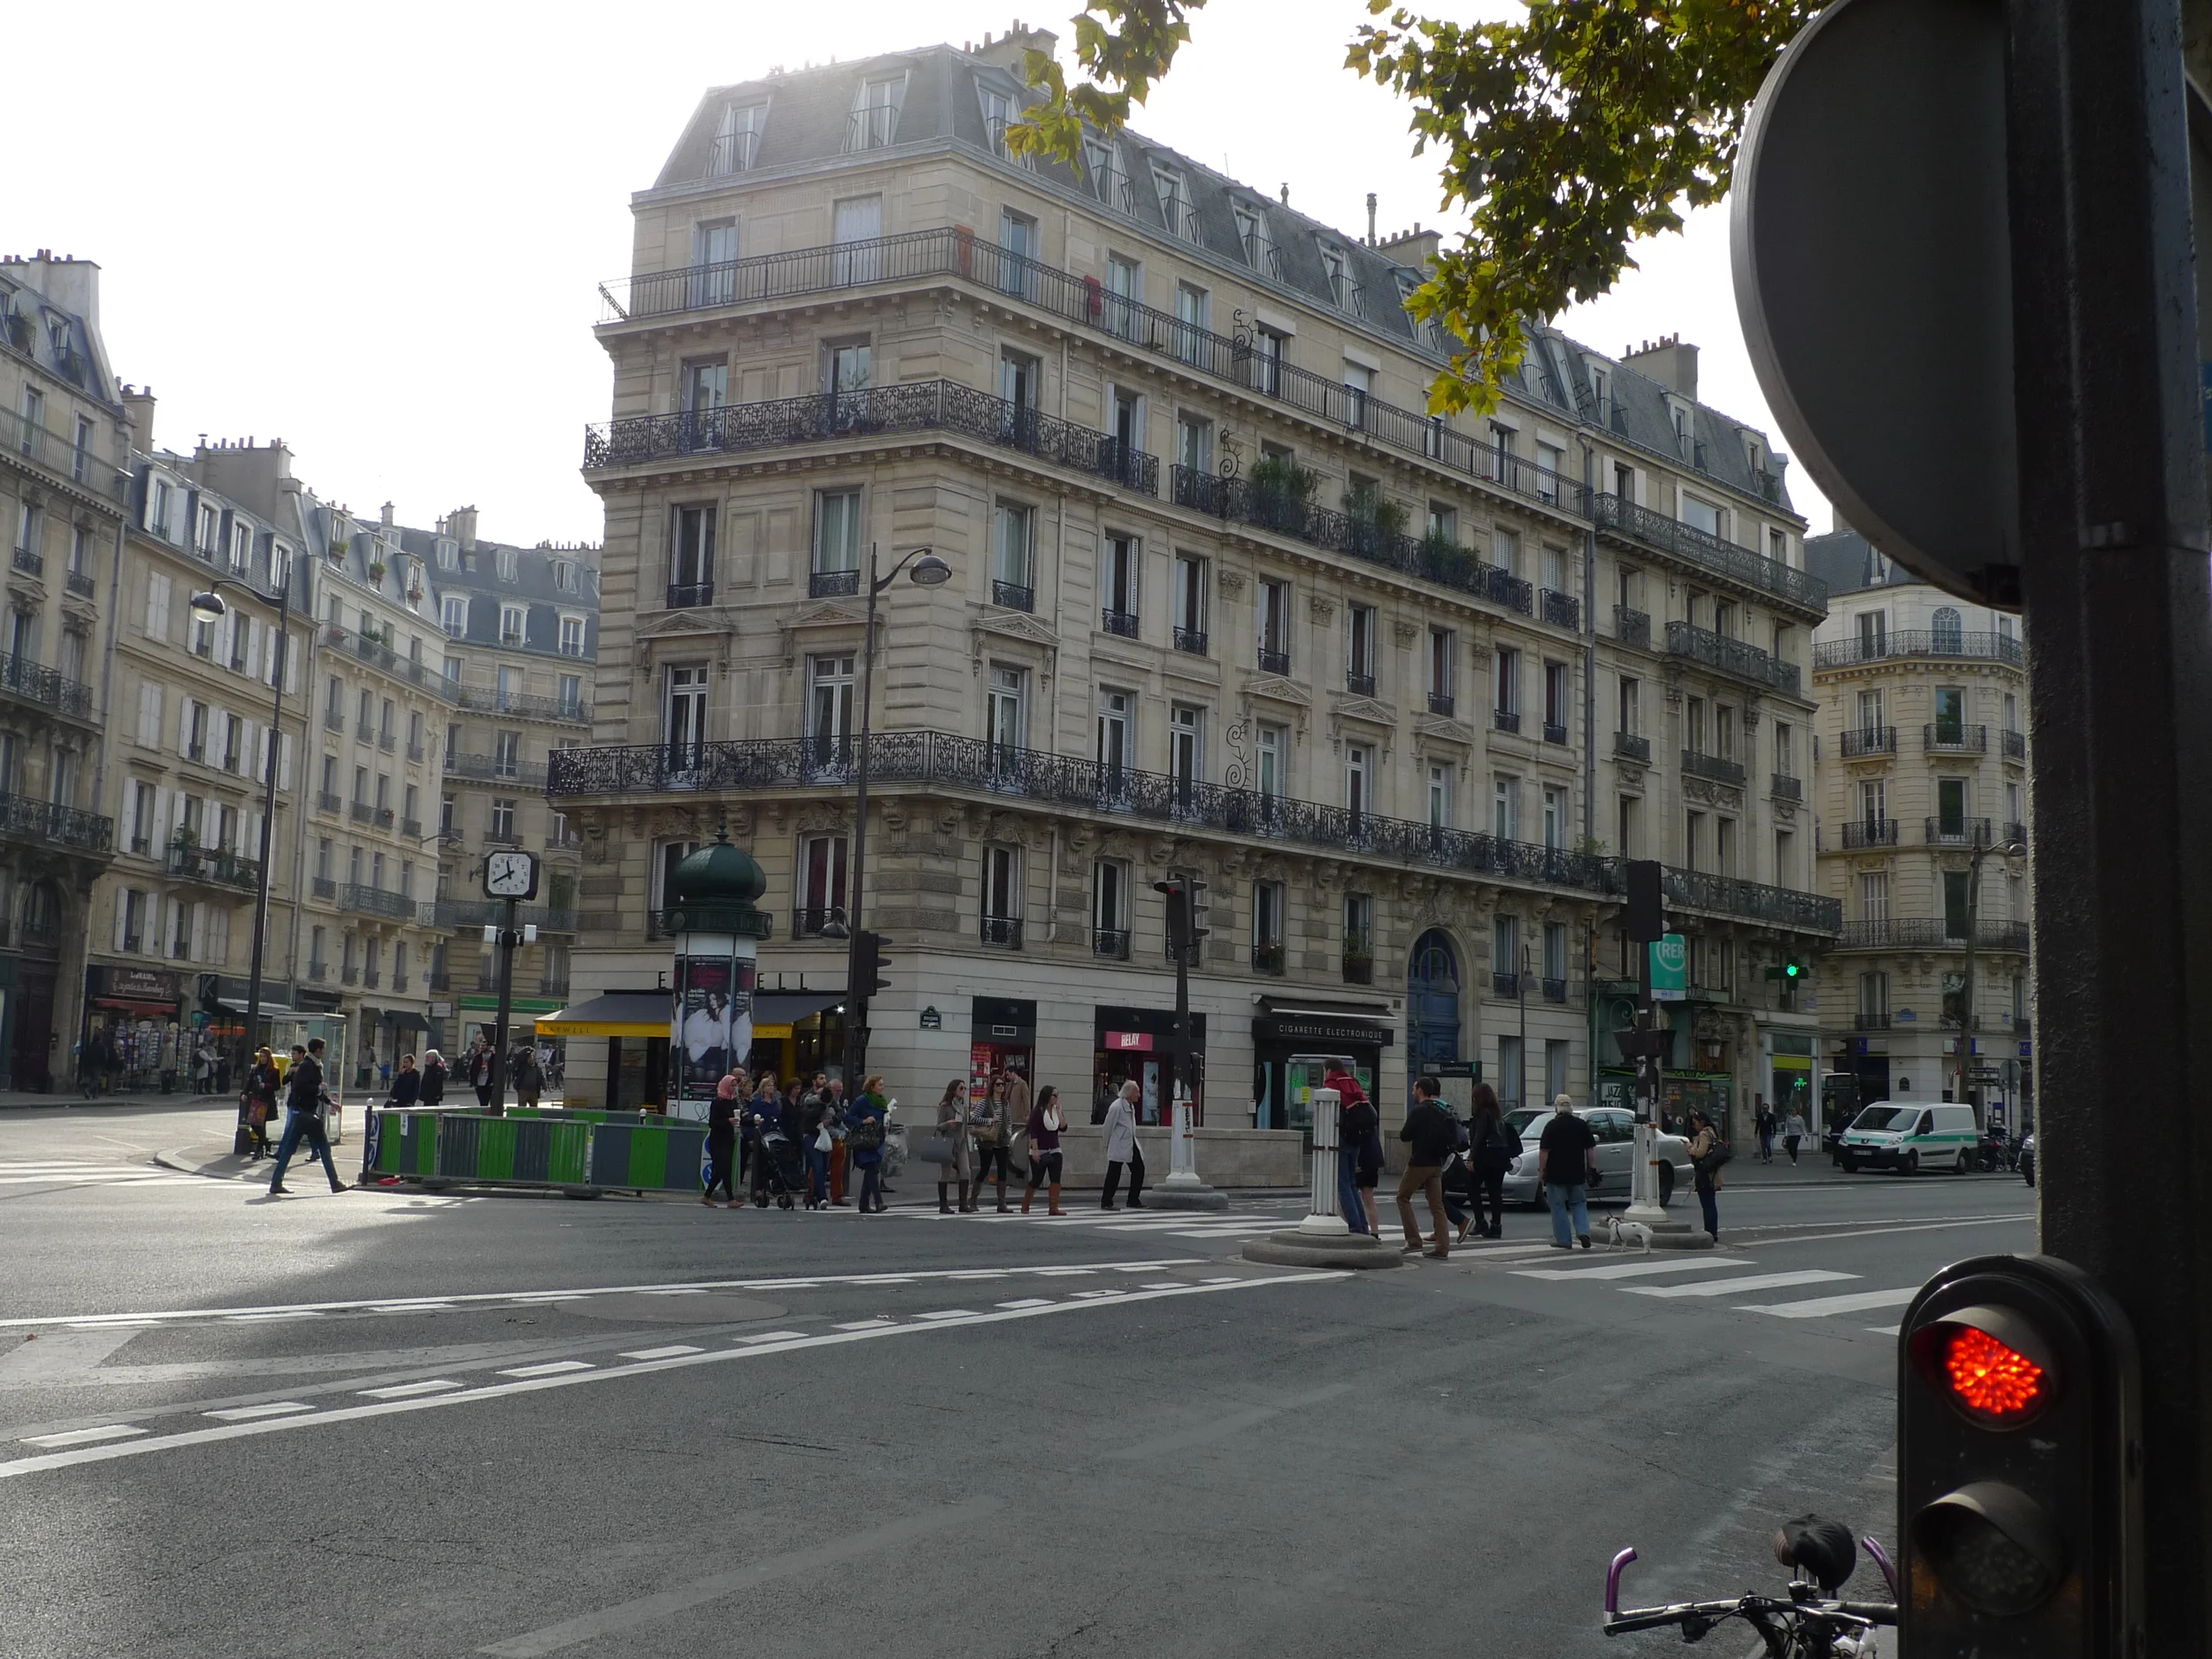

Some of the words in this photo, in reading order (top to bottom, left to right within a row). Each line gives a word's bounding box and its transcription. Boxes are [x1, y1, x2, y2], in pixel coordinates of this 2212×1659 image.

[1662, 943, 1685, 959] RER
[1279, 1025, 1323, 1035] CIGARETTE
[1326, 1028, 1383, 1040] ELECTRONIQUE
[1121, 1033, 1141, 1048] RELAY
